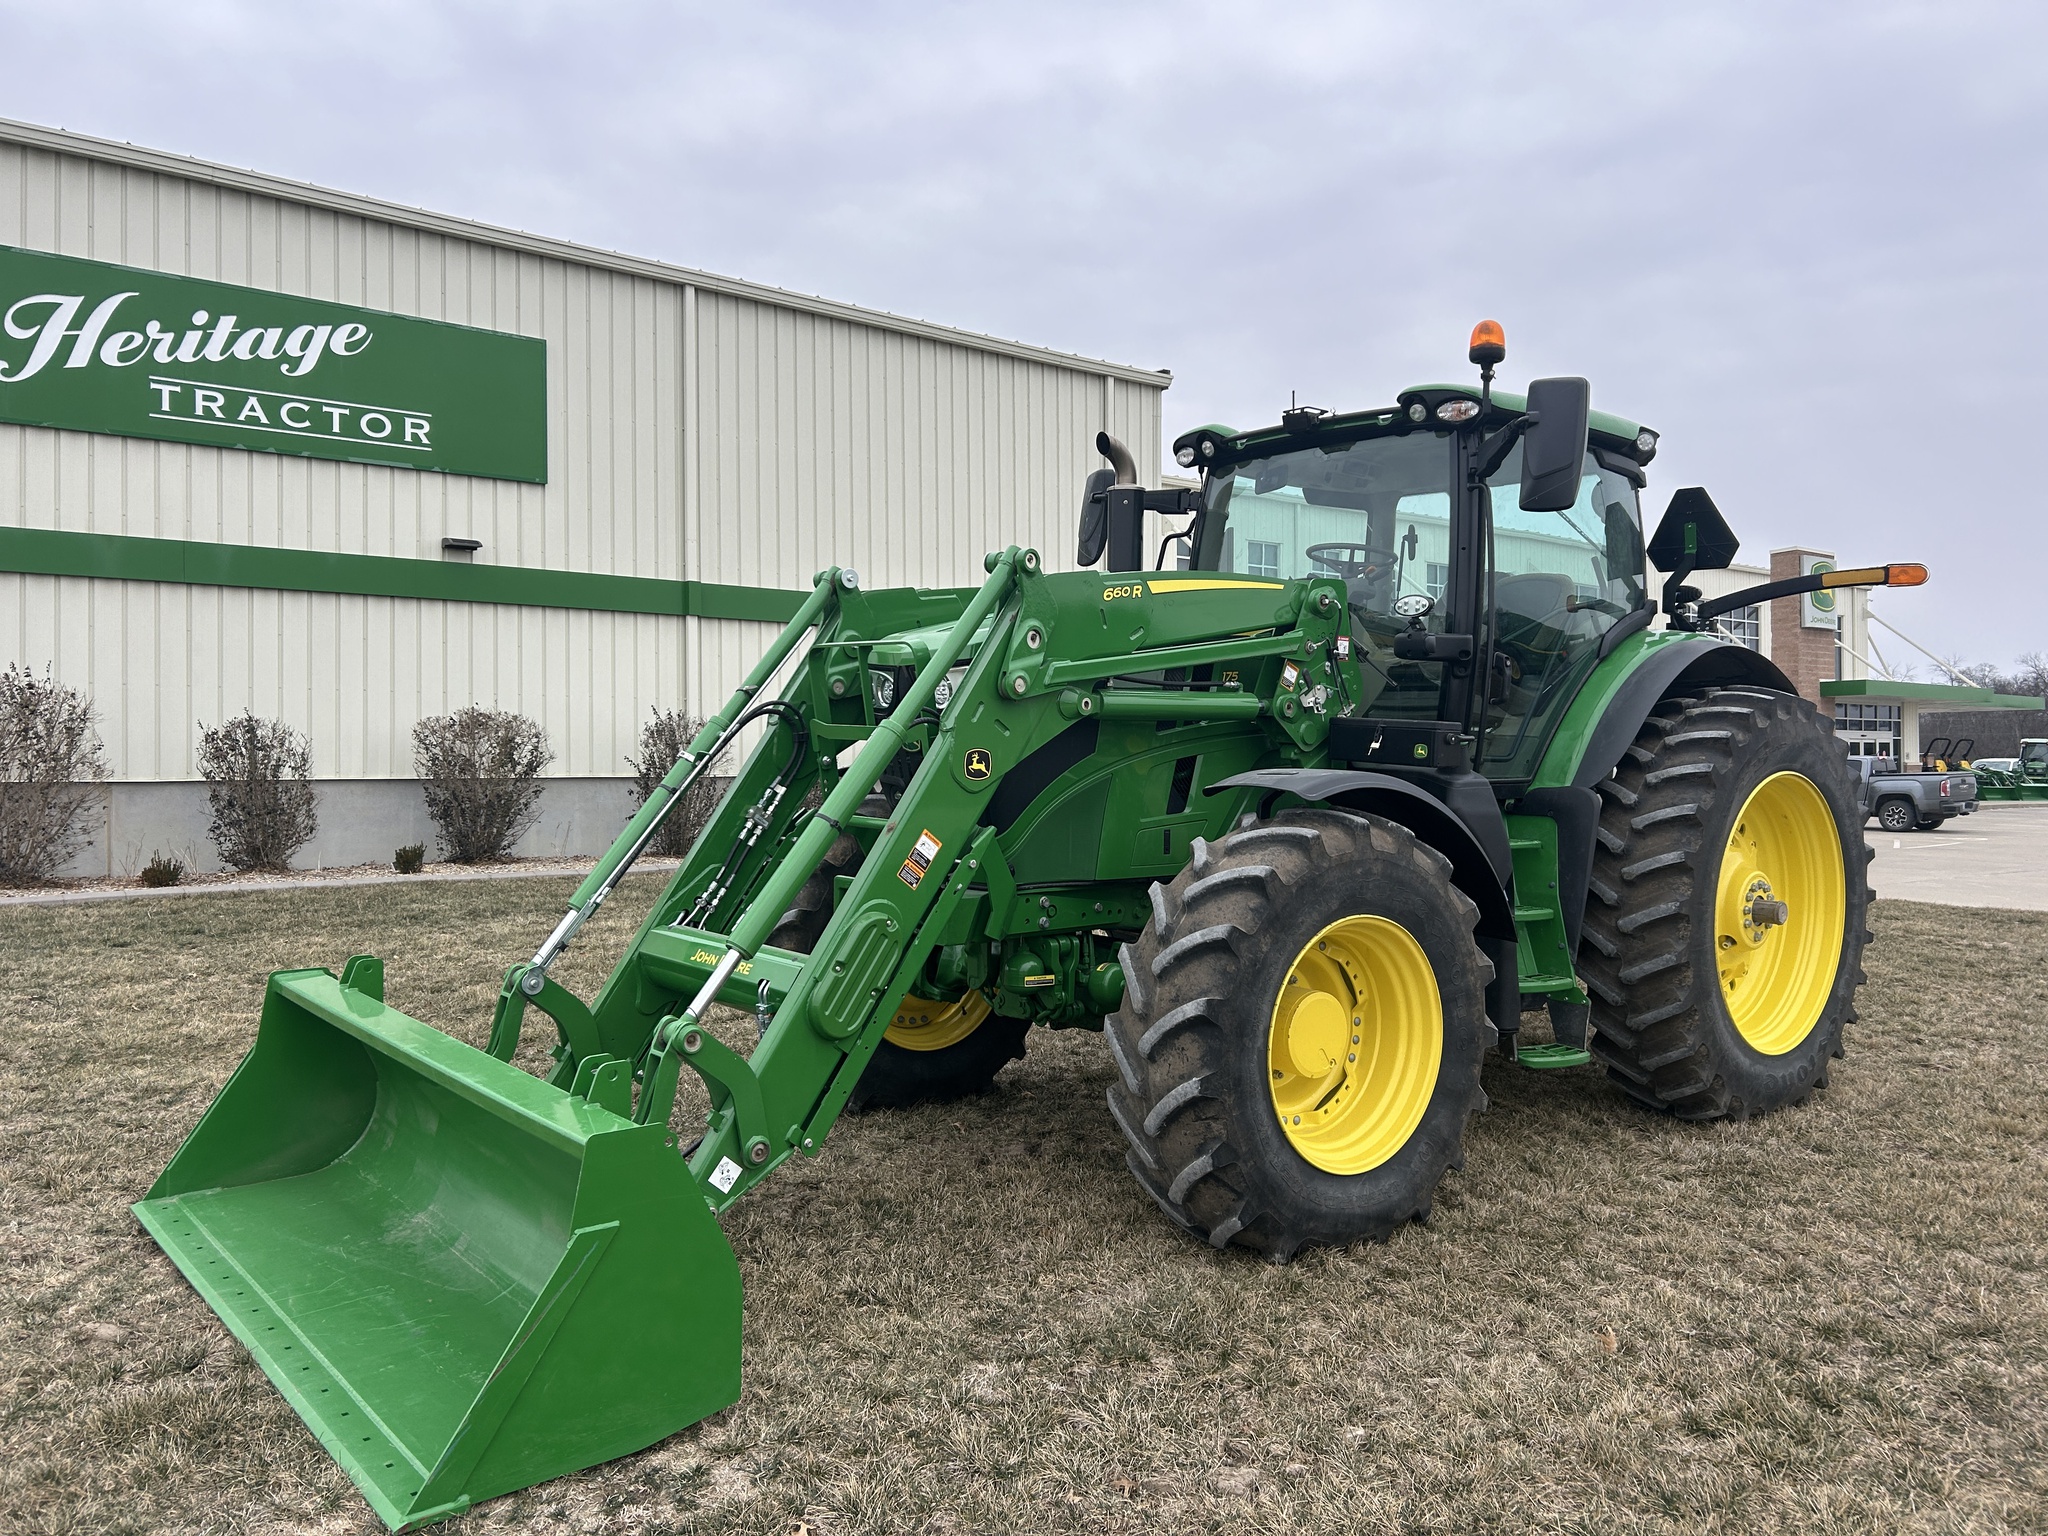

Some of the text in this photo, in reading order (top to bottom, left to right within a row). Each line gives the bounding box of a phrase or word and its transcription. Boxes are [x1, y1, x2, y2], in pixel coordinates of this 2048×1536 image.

[0, 291, 373, 382] Heritage
[150, 382, 431, 444] TRACTOR
[1222, 671, 1239, 682] 175
[690, 948, 719, 966] JOHN
